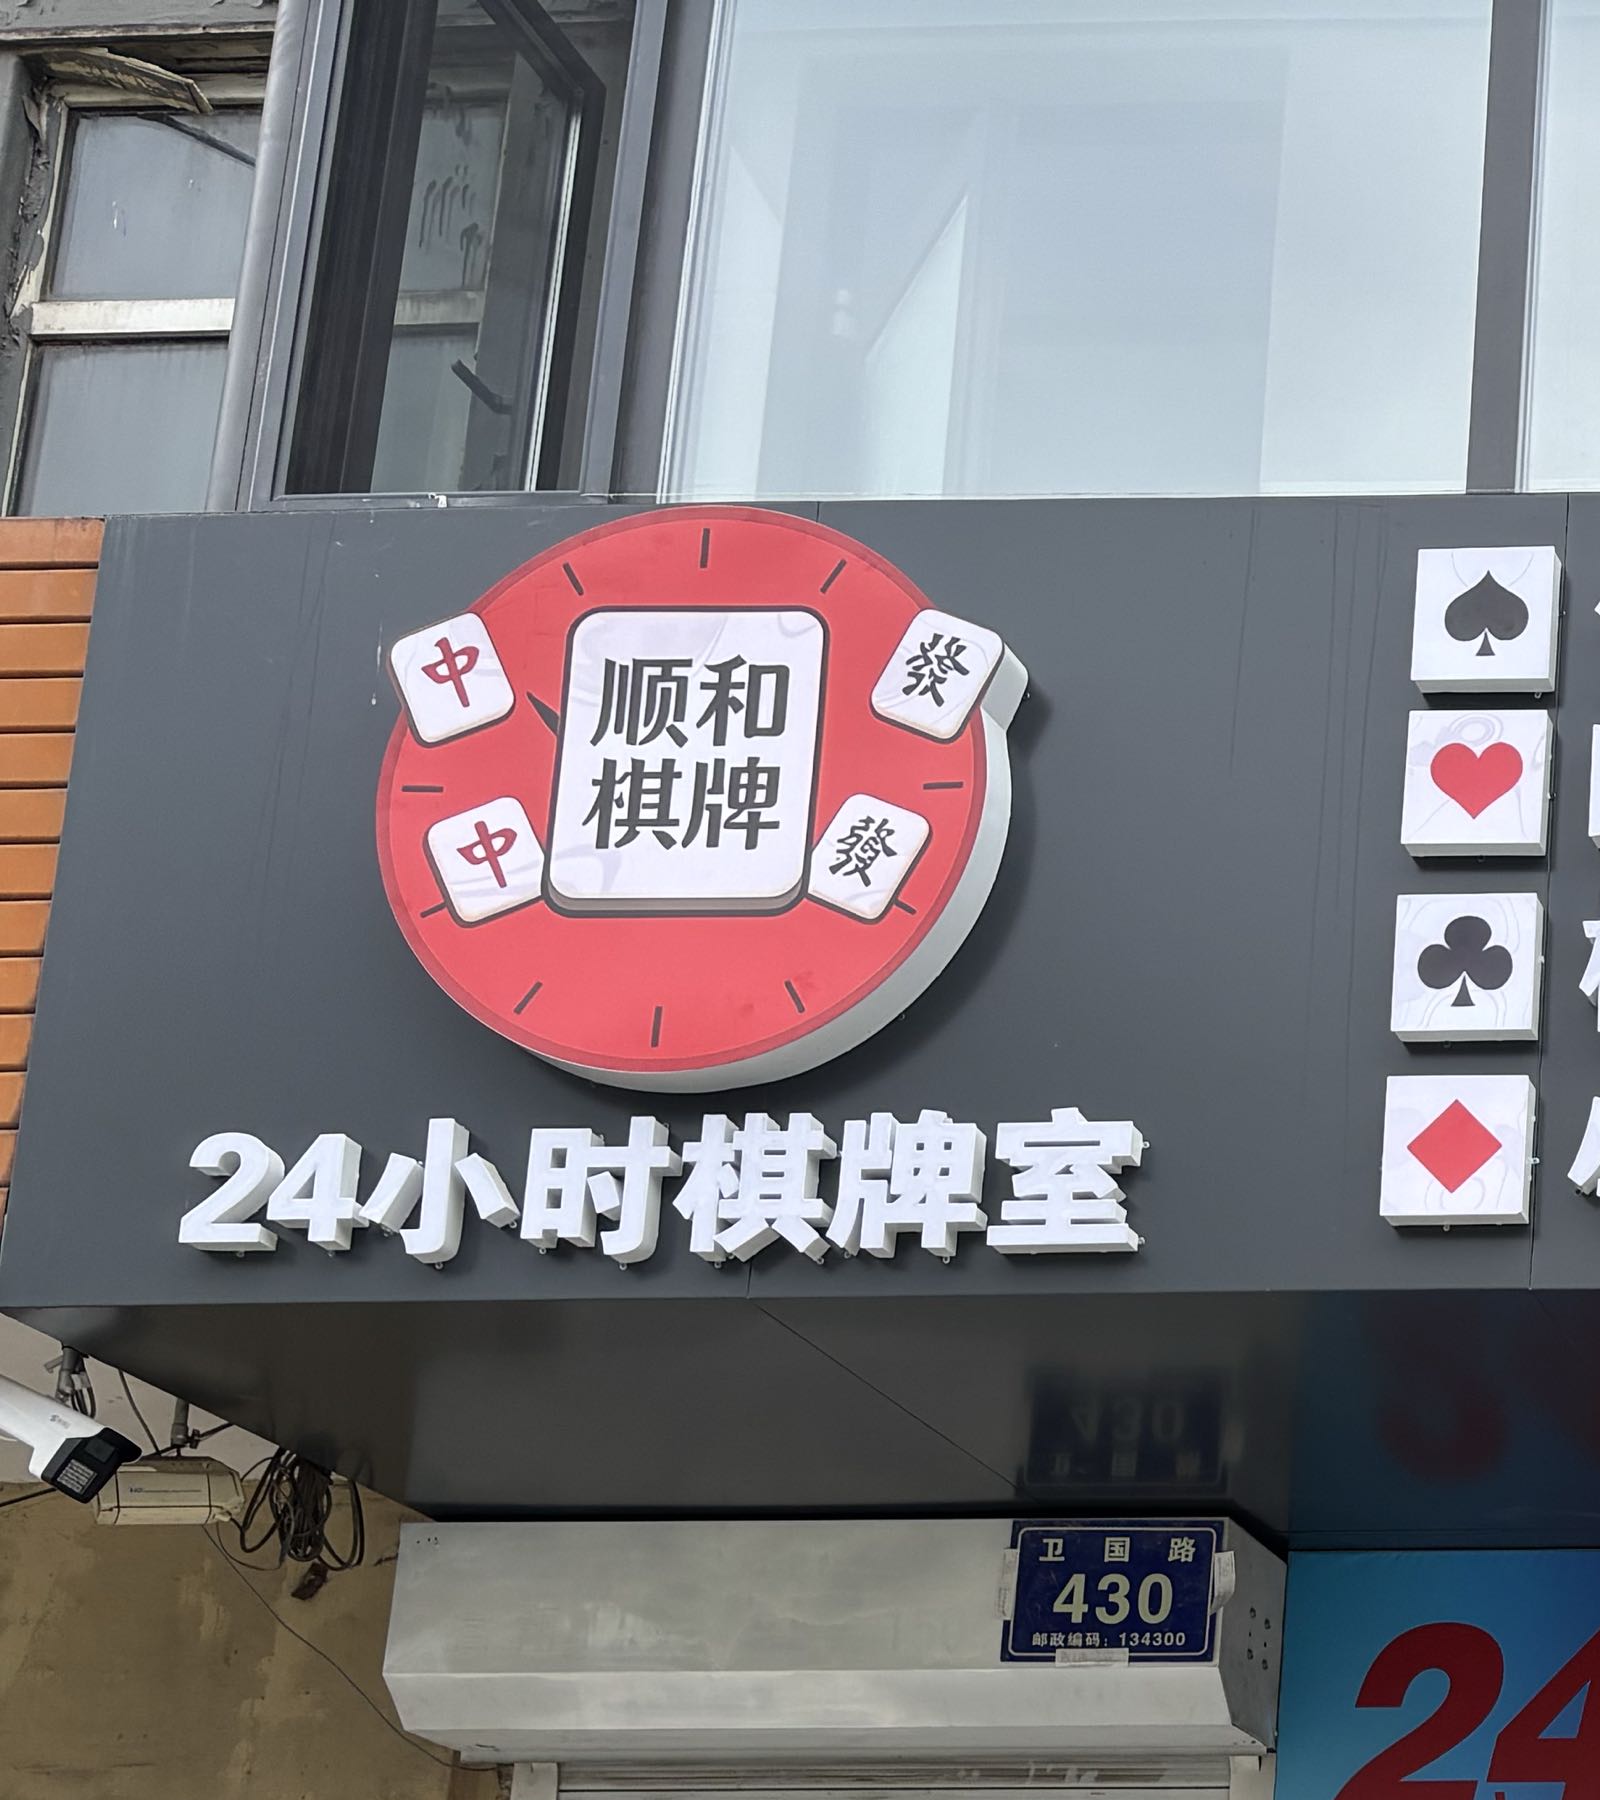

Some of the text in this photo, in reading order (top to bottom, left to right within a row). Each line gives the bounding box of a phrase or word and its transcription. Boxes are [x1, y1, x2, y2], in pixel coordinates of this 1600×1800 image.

[421, 637, 479, 707] 中
[590, 654, 790, 747] 顺和
[582, 757, 781, 850] 棋牌
[457, 821, 517, 888] 中
[829, 816, 898, 888] 發
[178, 1108, 1149, 1264] 24小时棋牌室
[1039, 1536, 1197, 1562] 卫国路
[1053, 1573, 1173, 1624] 430
[1119, 1632, 1186, 1646] 134300
